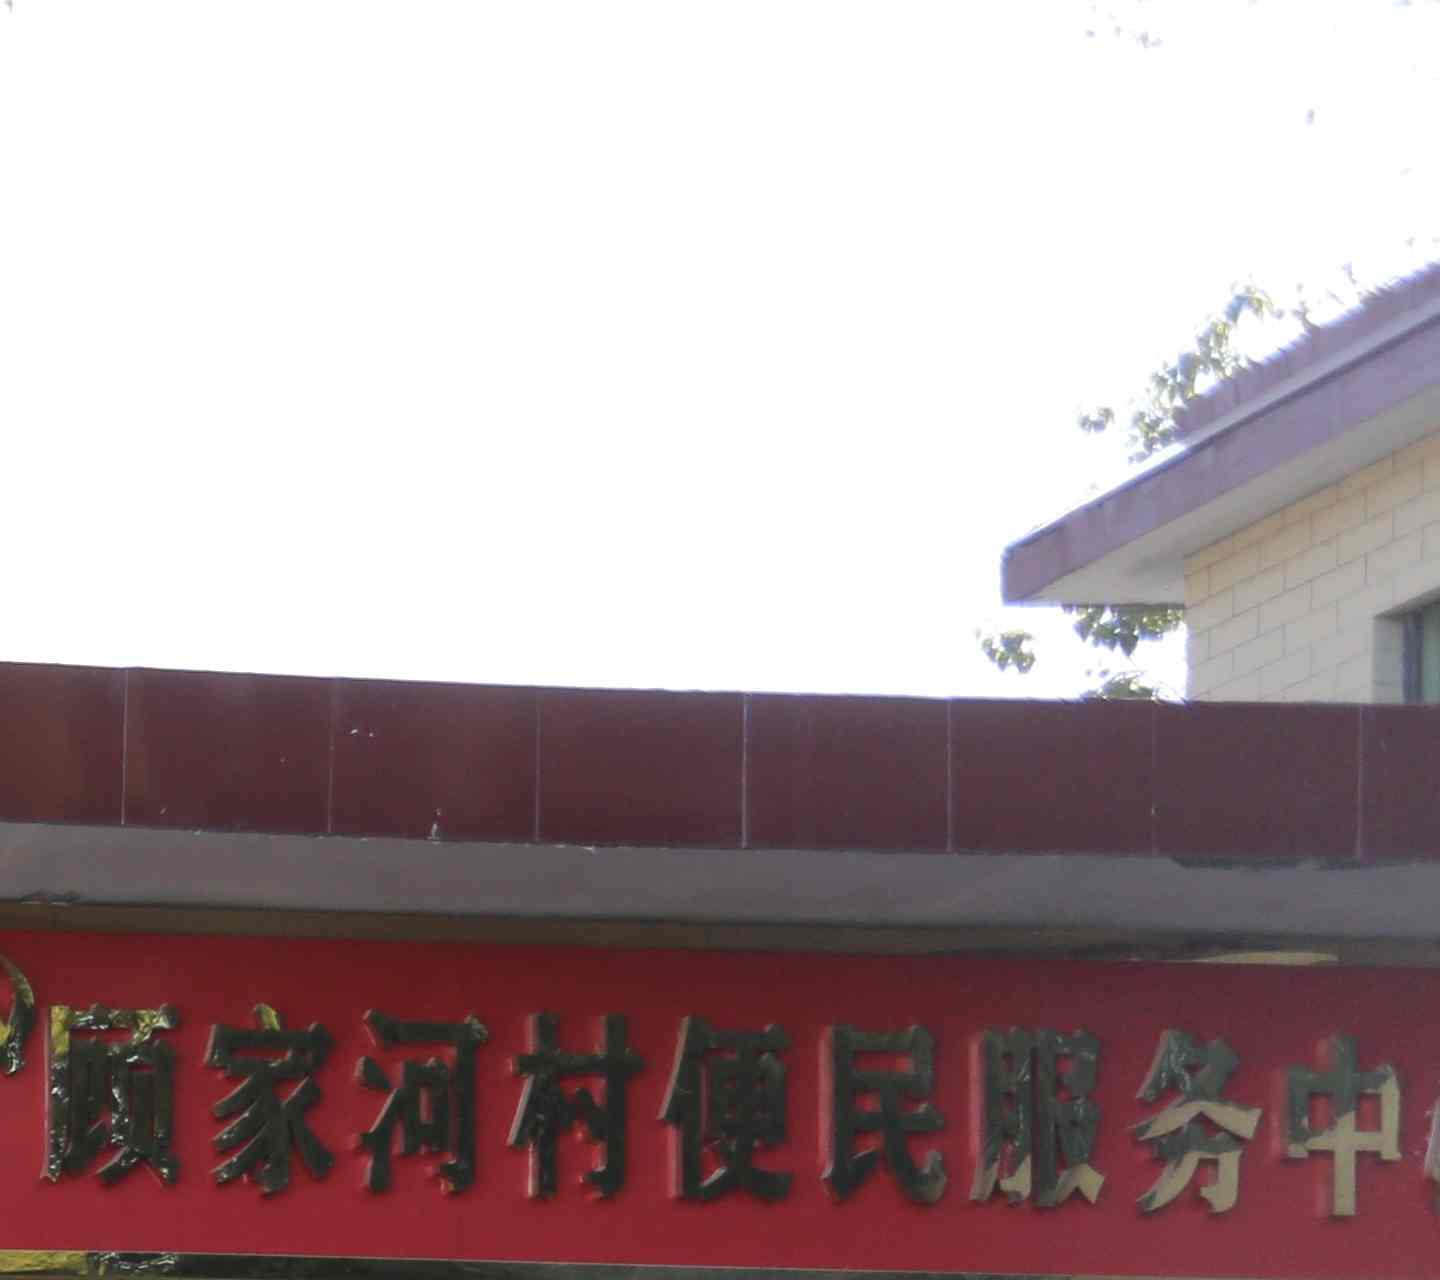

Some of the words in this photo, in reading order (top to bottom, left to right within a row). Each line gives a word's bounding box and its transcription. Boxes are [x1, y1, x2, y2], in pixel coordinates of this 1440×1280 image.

[42, 1000, 1440, 1220] 顾家河村便民服务中
